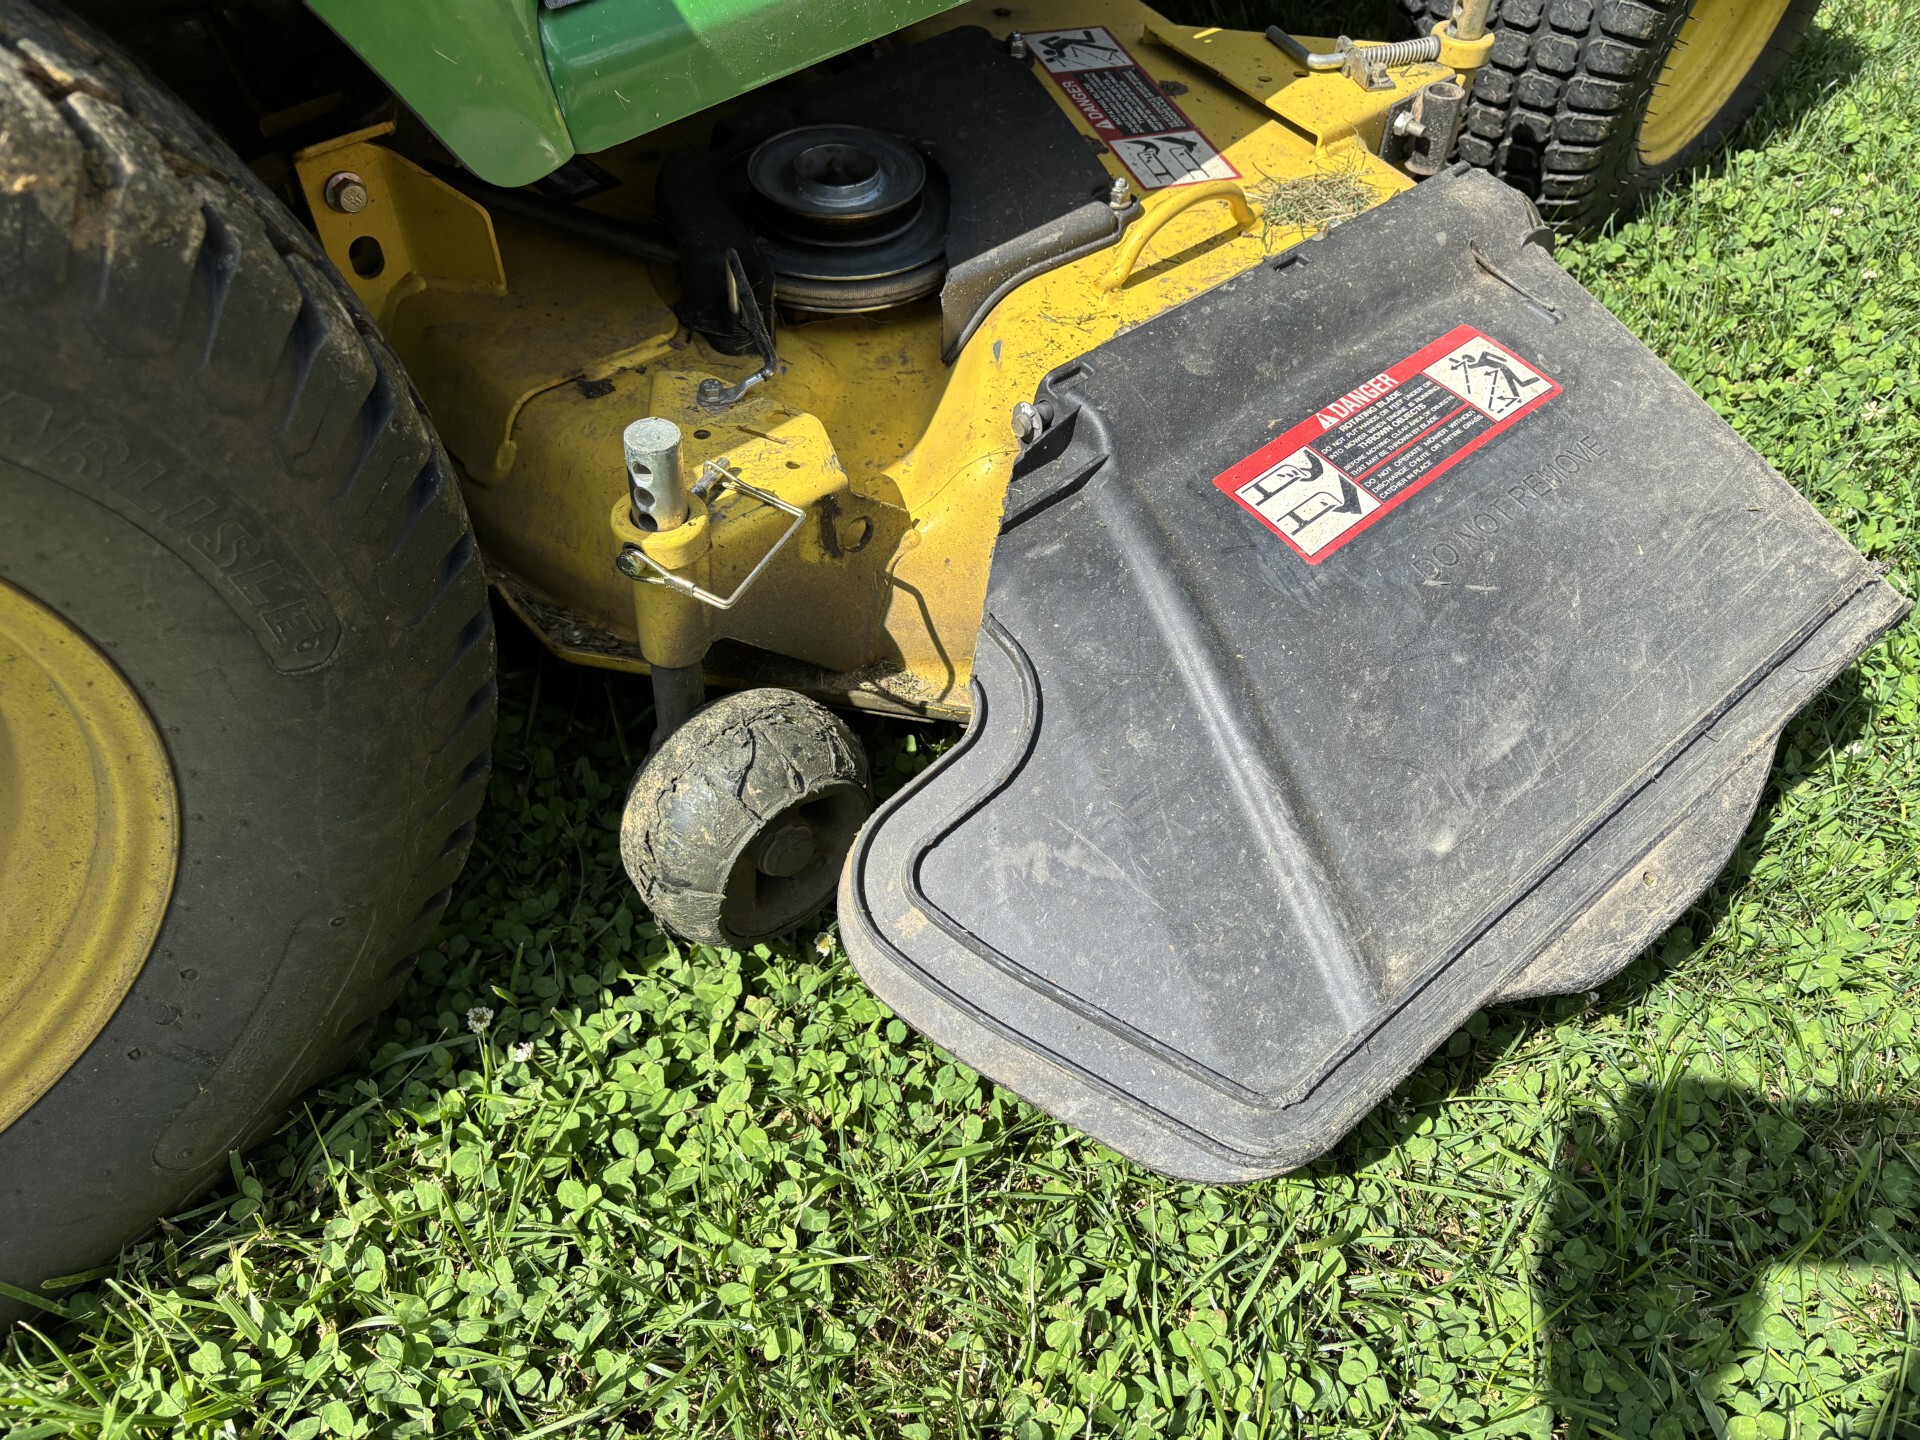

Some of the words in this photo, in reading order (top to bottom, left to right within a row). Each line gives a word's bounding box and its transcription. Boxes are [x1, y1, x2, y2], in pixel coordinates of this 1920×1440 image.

[1062, 81, 1104, 119] DANGER
[1321, 445, 1332, 454] DO
[1332, 437, 1346, 447] NOT
[1346, 428, 1359, 438] PUT
[1359, 415, 1380, 430] HANDS
[1379, 408, 1389, 416] OR
[1389, 399, 1405, 410] FEET
[1403, 386, 1424, 400] UNDER
[1423, 380, 1433, 388] OR
[1327, 373, 1399, 418] DANGER
[1339, 406, 1378, 432] ROTATING
[1376, 390, 1403, 408] BLADE
[1328, 448, 1344, 460] INTO
[1344, 432, 1368, 449] MOWER
[1367, 420, 1387, 434] WHEN
[1386, 406, 1408, 421] ENGINE
[1343, 454, 1367, 470] BEFORE
[1391, 425, 1410, 438] CLEAR
[1430, 395, 1455, 412] OBJECTS
[1358, 425, 1393, 449] THROWN
[1391, 403, 1427, 427] OBJECTS
[1364, 478, 1376, 487] DO
[1377, 467, 1393, 478] NOT
[1393, 445, 1423, 467] OPERATE
[1423, 428, 1448, 446] MOWER
[1448, 410, 1475, 429] WITHOUT
[1350, 464, 1367, 476] THAT
[1365, 455, 1380, 466] MAY
[1378, 449, 1389, 457] BE
[1387, 432, 1413, 451] THROWN
[1371, 466, 1410, 493] DISCHARGE
[1408, 451, 1431, 467] CHUTE
[1430, 443, 1441, 452] OR
[1440, 428, 1463, 444] ENTIRE
[1462, 414, 1483, 429] GRASS
[1379, 478, 1408, 499] CATCHER
[1413, 460, 1434, 475] PLACE
[1412, 543, 1459, 580] DO
[1453, 499, 1513, 550] NOT
[1507, 436, 1608, 509] REMOVE
